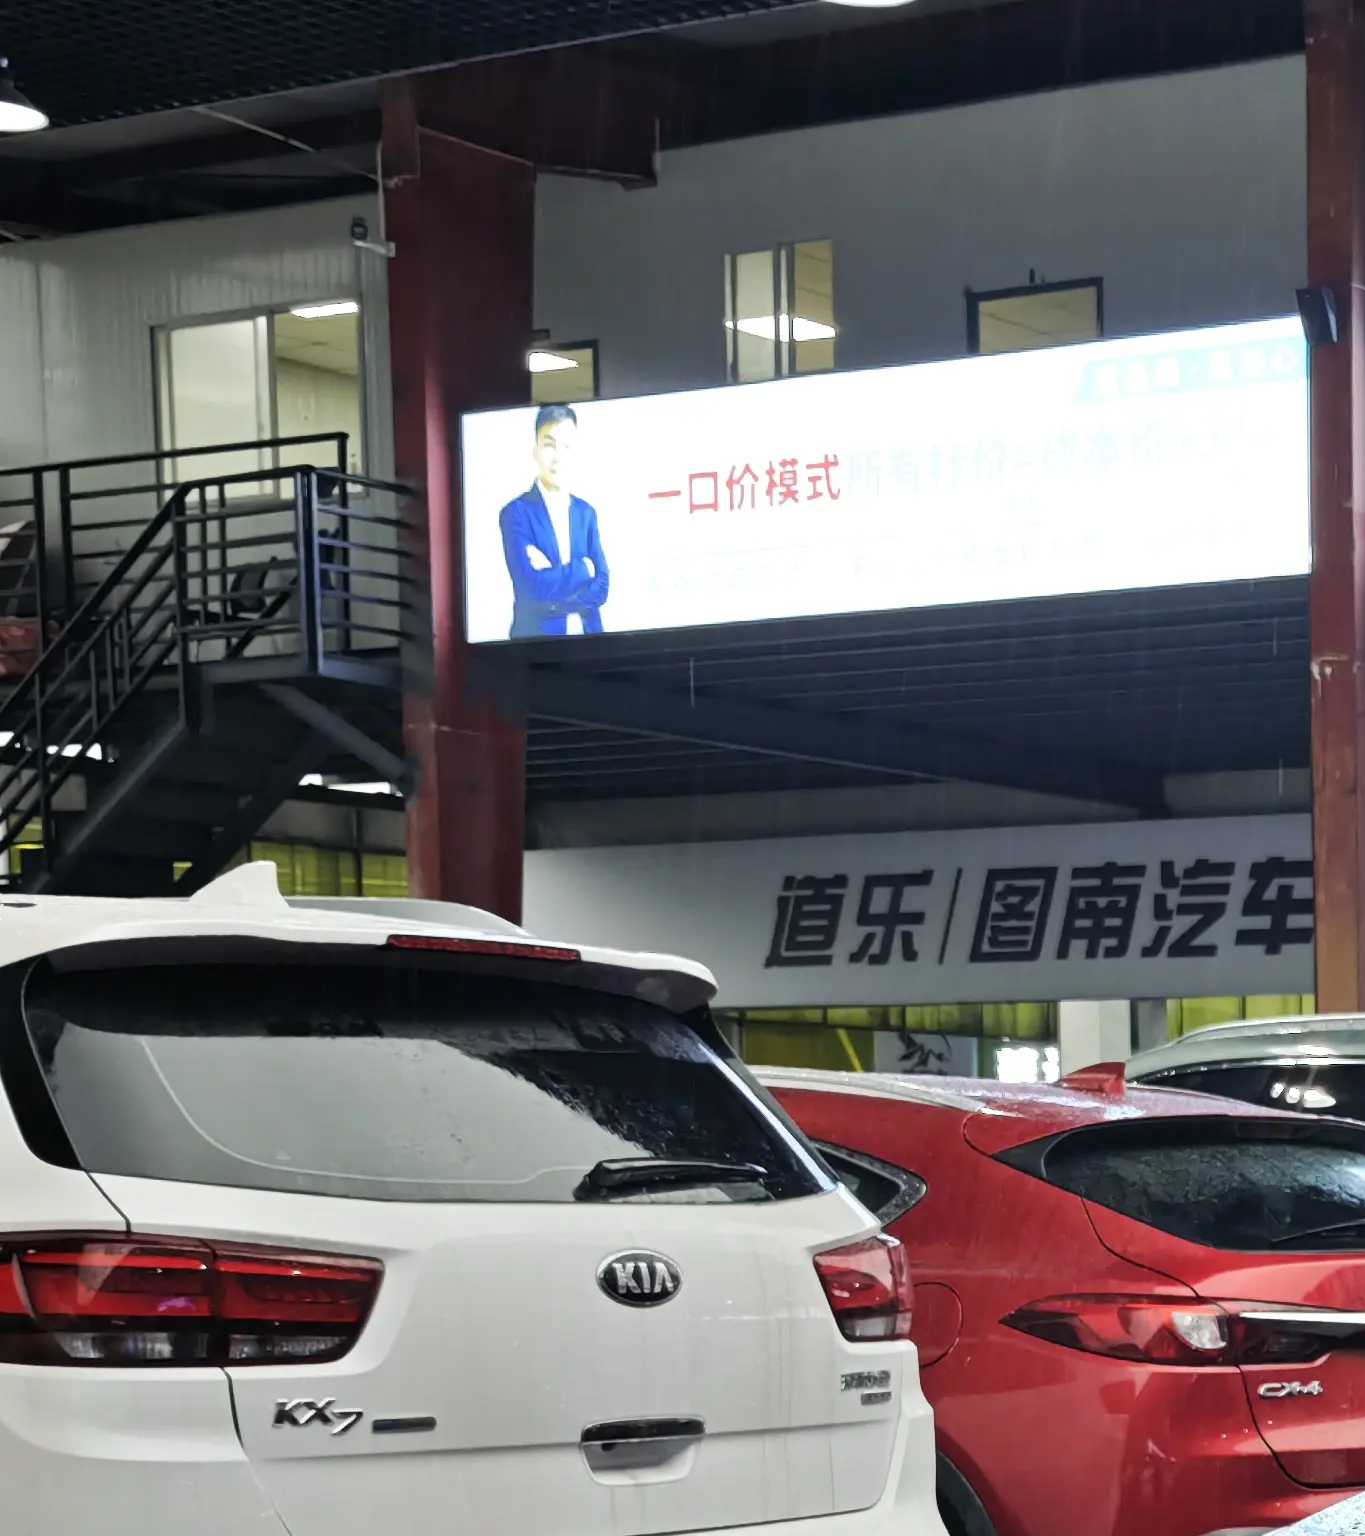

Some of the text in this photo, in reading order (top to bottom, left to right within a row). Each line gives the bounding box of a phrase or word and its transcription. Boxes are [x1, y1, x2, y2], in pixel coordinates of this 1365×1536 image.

[646, 453, 843, 515] 一口价模式
[612, 1261, 674, 1294] KIA
[1256, 1379, 1324, 1398] CX-4
[272, 1396, 364, 1436] KX7
